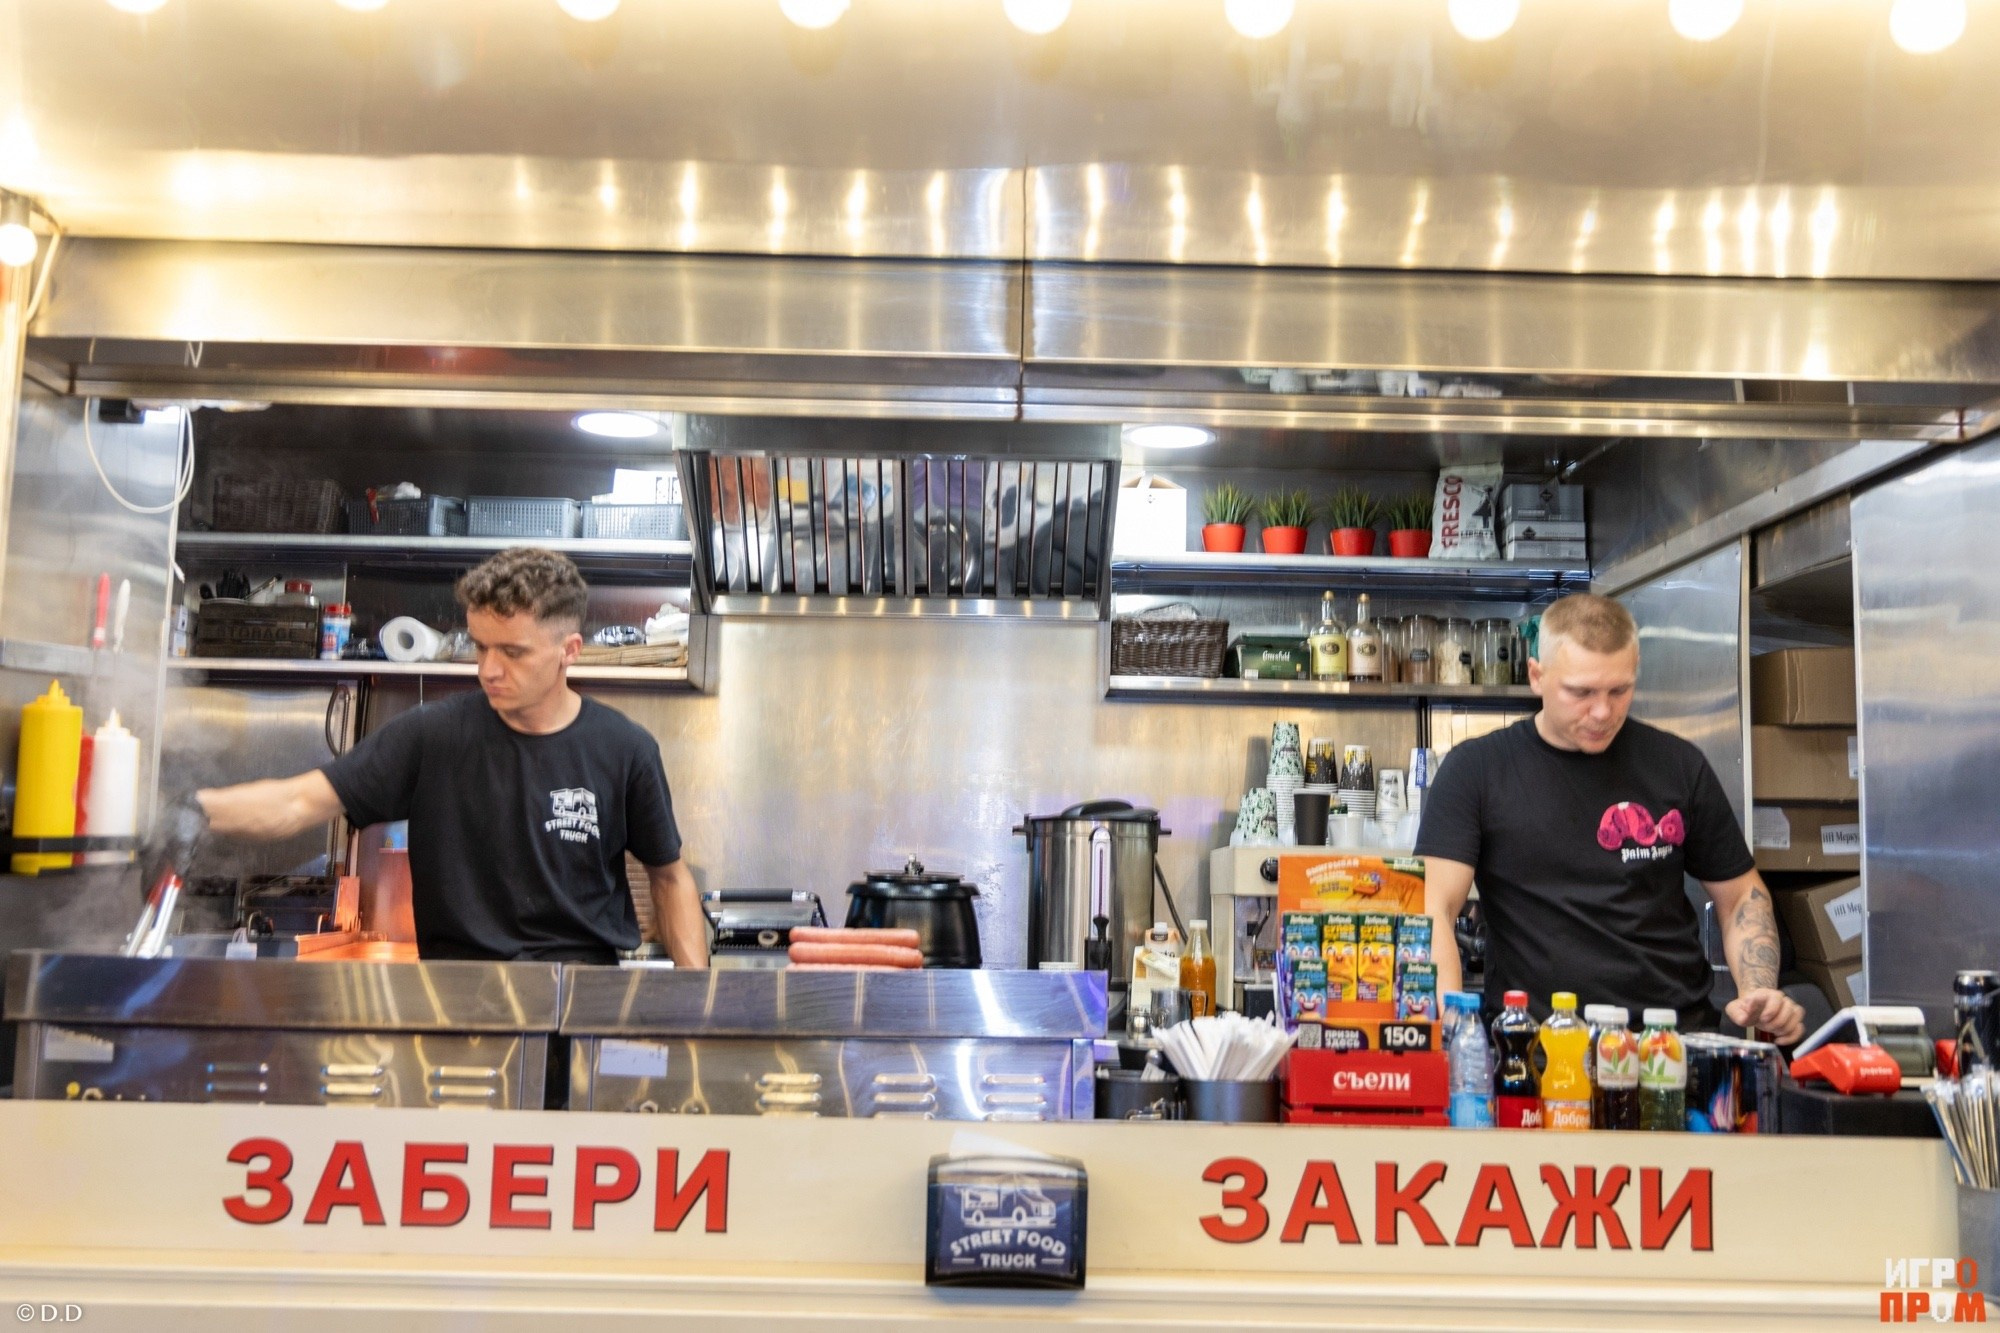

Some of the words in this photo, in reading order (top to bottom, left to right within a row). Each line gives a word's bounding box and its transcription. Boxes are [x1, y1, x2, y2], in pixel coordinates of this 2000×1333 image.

[1441, 475, 1463, 549] FRESCO
[545, 818, 577, 832] STREET
[560, 829, 589, 844] TRUCK
[1621, 846, 1650, 863] Palm
[1325, 1029, 1360, 1038] ПРИЗЫ
[1333, 1071, 1410, 1091] съели
[222, 1136, 730, 1234] ЗАБЕРИ
[1199, 1156, 1714, 1252] ЗАКАЖИ
[950, 1229, 1013, 1257] STREET
[1016, 1229, 1067, 1257] FOOD
[979, 1252, 1038, 1269] TRUCK
